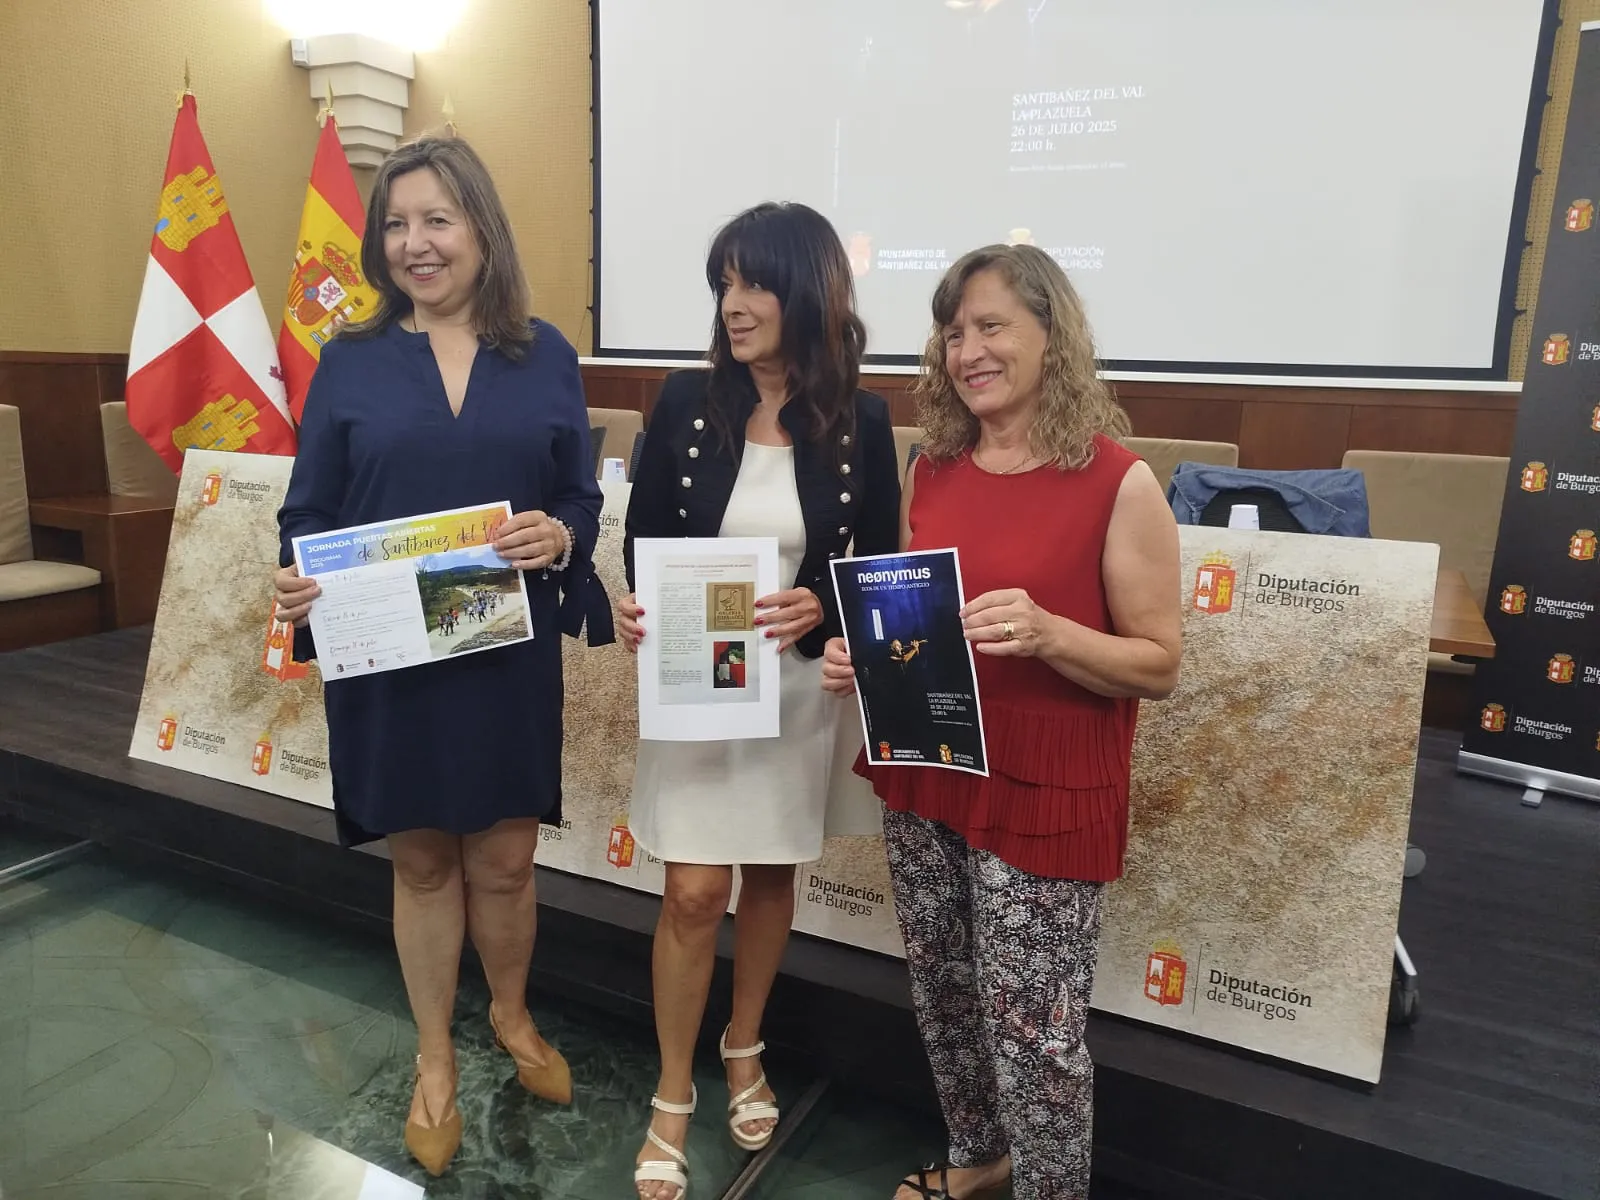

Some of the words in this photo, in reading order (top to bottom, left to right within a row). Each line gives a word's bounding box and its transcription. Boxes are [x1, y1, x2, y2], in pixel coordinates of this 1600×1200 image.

[1012, 88, 1091, 106] SANTIBAÑEZ
[1094, 88, 1119, 100] DEL
[1122, 85, 1146, 98] VAL
[1030, 105, 1092, 121] PLAZUELA
[1011, 125, 1026, 137] 26
[1028, 124, 1045, 136] DE
[1047, 121, 1085, 136] JULIO
[1087, 119, 1118, 133] 2025
[1010, 140, 1043, 152] 22:00
[878, 249, 935, 259] AYUNTAMIENTO
[936, 249, 947, 258] DE
[1578, 352, 1592, 360] de
[229, 479, 271, 493] Diputación
[1556, 481, 1569, 490] de
[237, 491, 264, 504] Burgos
[307, 540, 352, 554] JORNADA
[353, 531, 393, 545] PUERTAS
[394, 524, 437, 538] ABIERTAS
[357, 543, 375, 562] de
[456, 523, 476, 544] del
[857, 567, 932, 585] neønymus
[1257, 573, 1361, 597] Diputación
[1255, 590, 1276, 605] de
[1280, 592, 1345, 614] Burgos
[1535, 596, 1595, 612] Diputación
[1534, 604, 1547, 614] de
[1548, 606, 1586, 619] Burgos
[1583, 674, 1596, 683] de
[1514, 724, 1526, 733] de
[1527, 726, 1563, 740] Burgos
[1515, 716, 1572, 734] Diputación
[184, 726, 226, 745] Diputación
[182, 738, 192, 747] de
[192, 739, 219, 755] Burgos
[281, 749, 327, 770] Diputación
[280, 761, 290, 772] de
[290, 764, 320, 780] Burgos
[541, 827, 562, 841] rgos
[809, 874, 885, 905] Diputación
[807, 889, 822, 904] de
[825, 893, 873, 917] Burgos
[1209, 969, 1313, 1008] Diputación
[1206, 986, 1227, 1004] de
[1231, 992, 1297, 1021] Burgos
